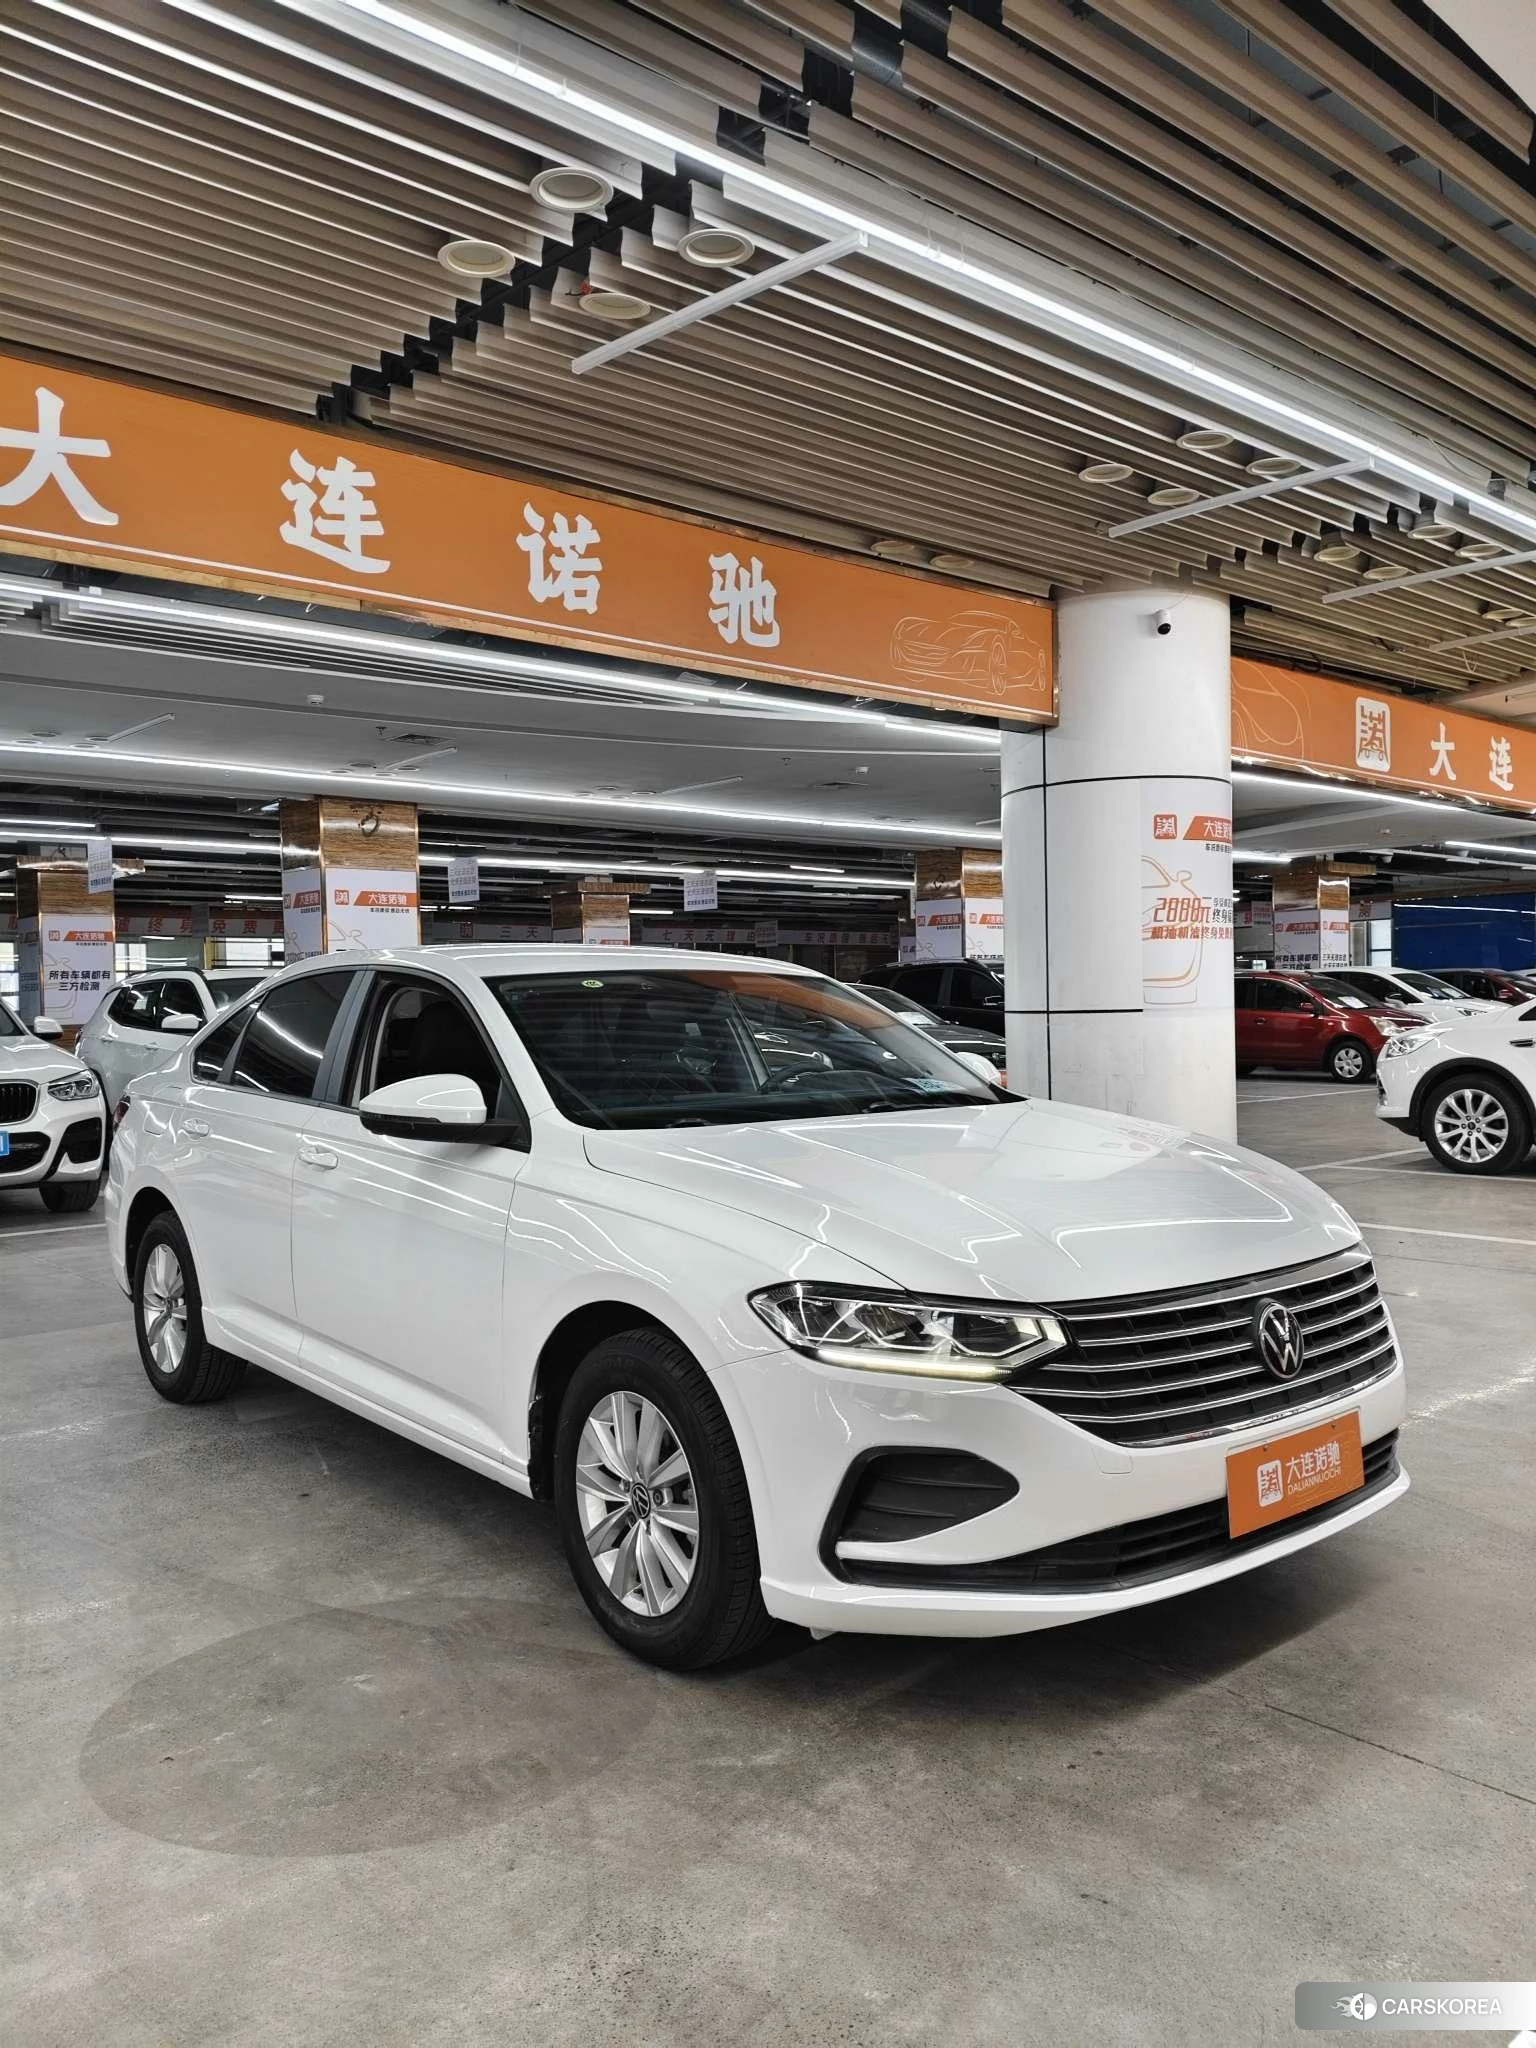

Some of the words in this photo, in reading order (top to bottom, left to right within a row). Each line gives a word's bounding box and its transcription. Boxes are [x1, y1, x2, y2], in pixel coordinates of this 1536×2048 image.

[0, 386, 780, 648] 大连诺驰
[1429, 721, 1514, 791] 大连
[1286, 1441, 1341, 1484] 大连诺驰
[1288, 1466, 1341, 1495] DALIANNUOCHI
